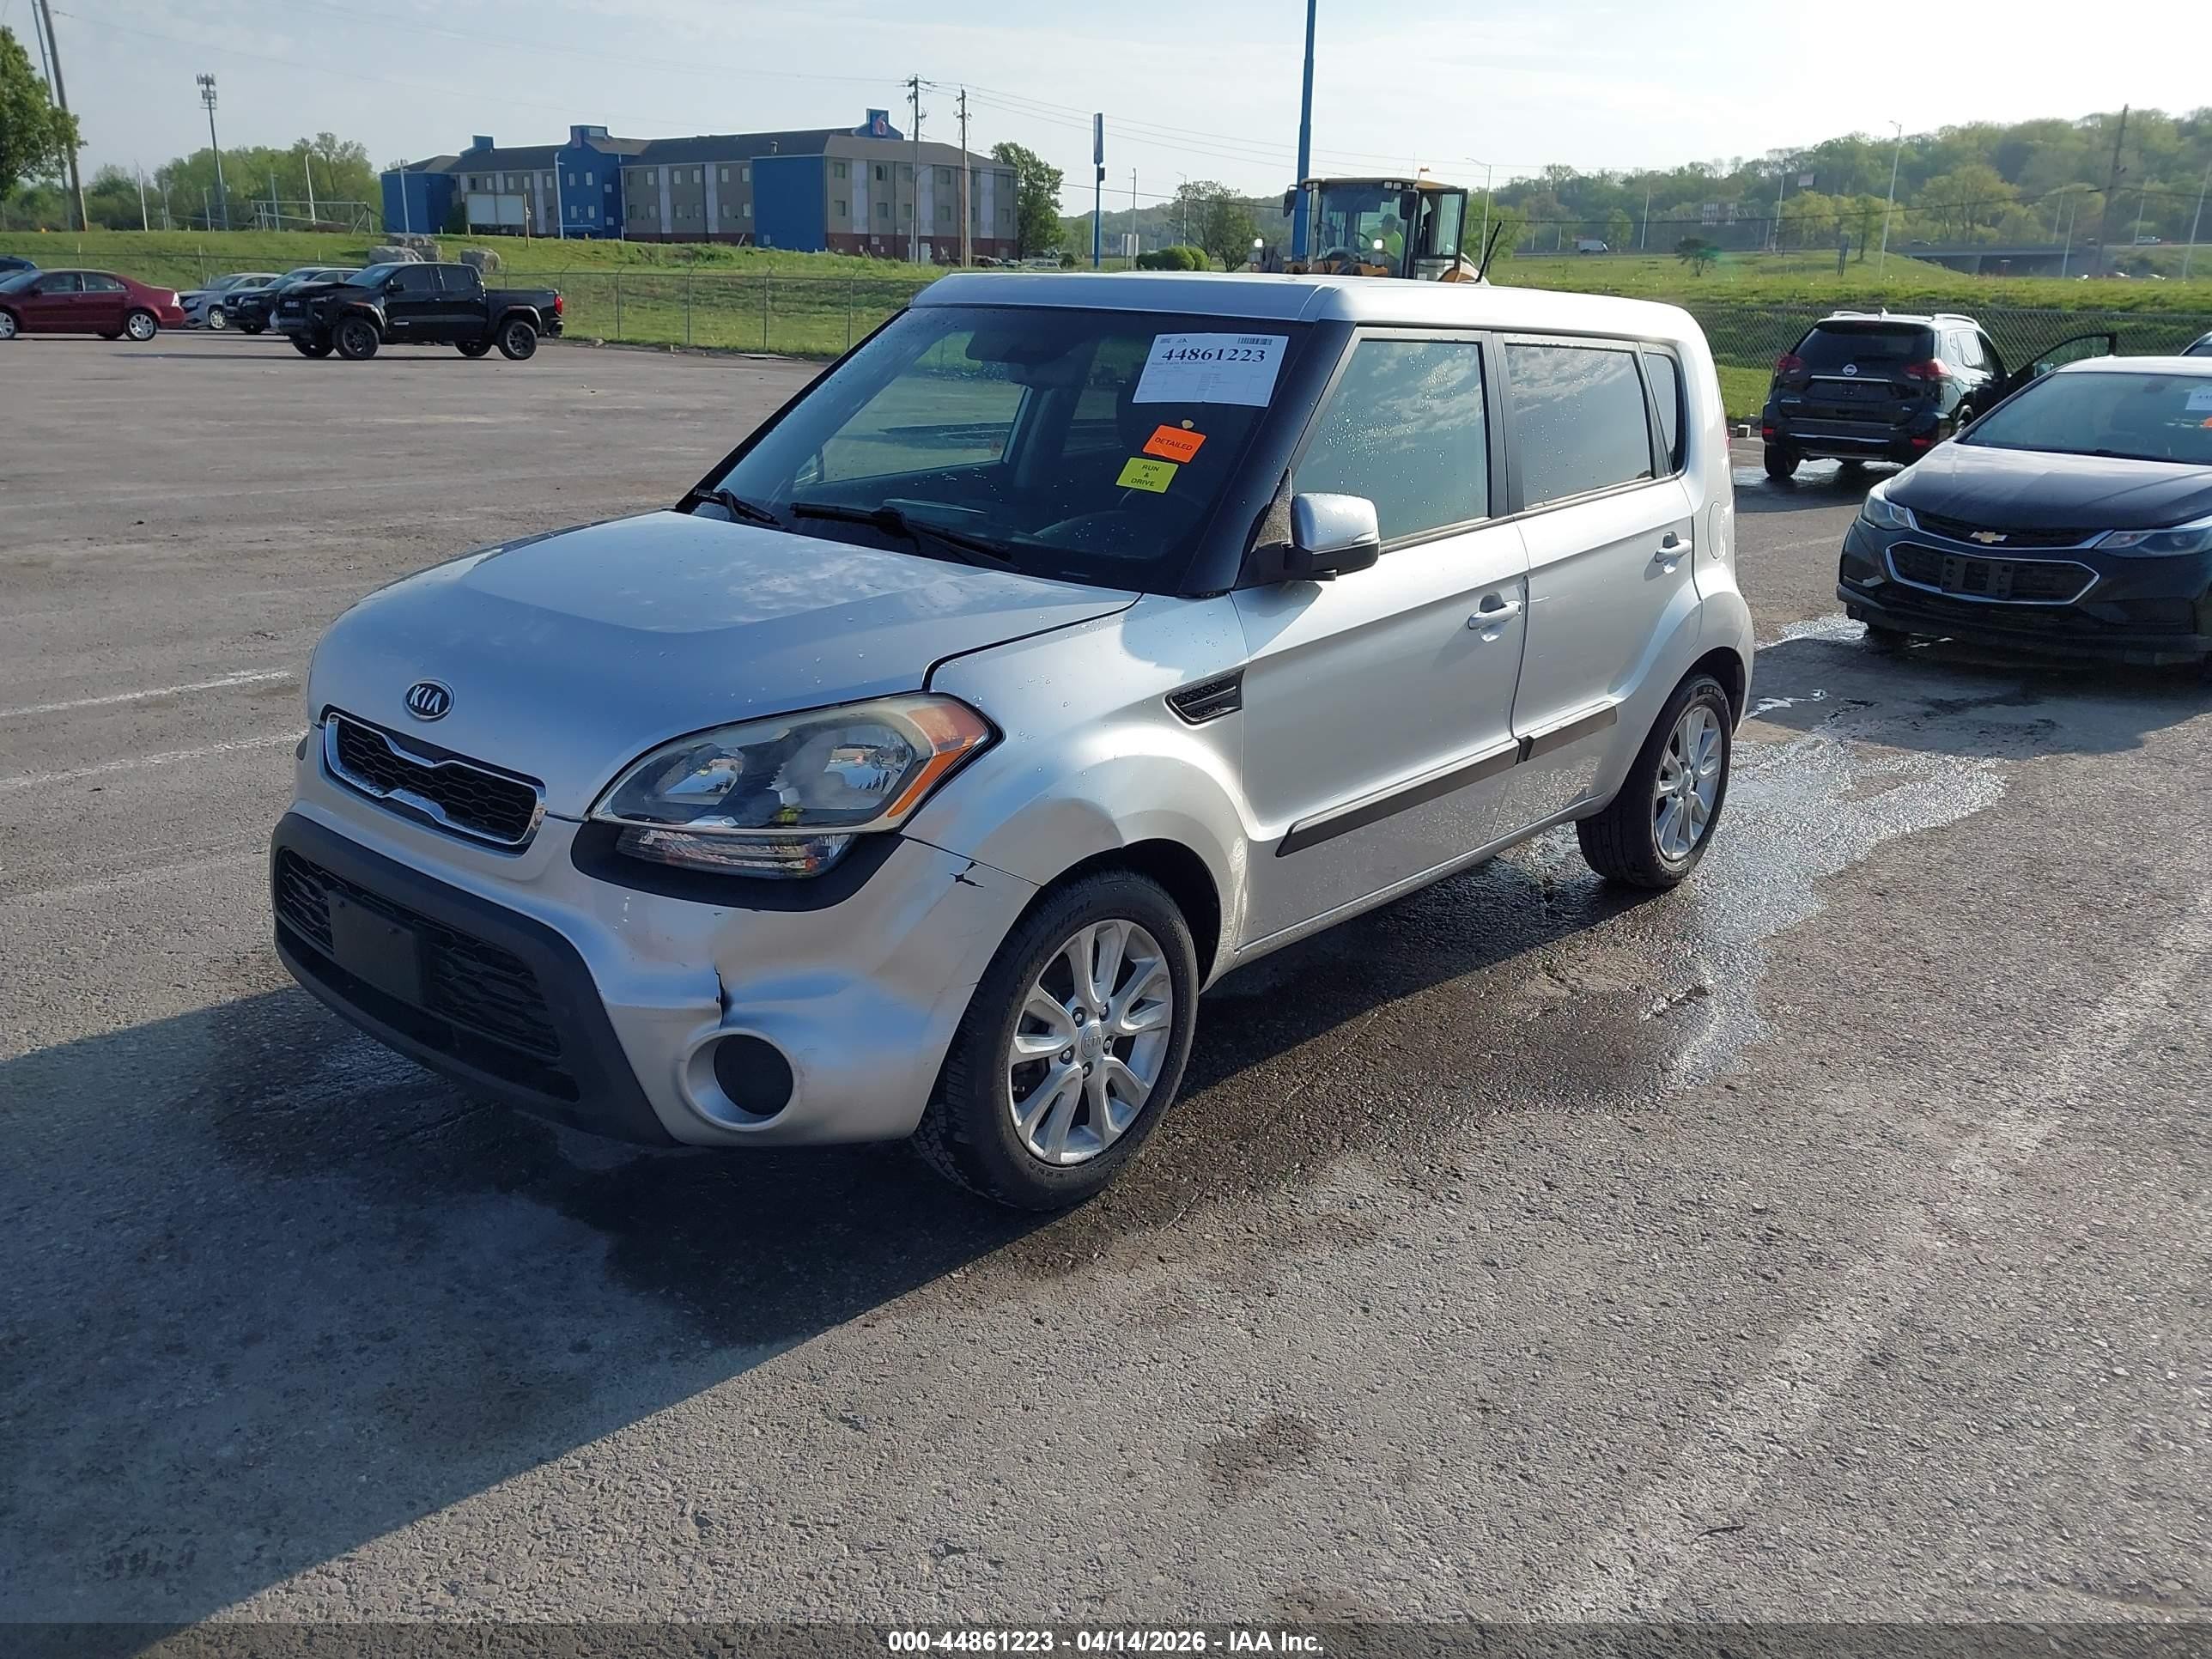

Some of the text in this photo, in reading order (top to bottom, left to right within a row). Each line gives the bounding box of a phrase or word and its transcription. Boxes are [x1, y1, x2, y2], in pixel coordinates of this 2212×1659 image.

[1162, 347, 1267, 363] 44861223
[1154, 436, 1194, 451] DETAILED
[1130, 477, 1156, 487] DRIVE
[410, 685, 443, 714] KIA
